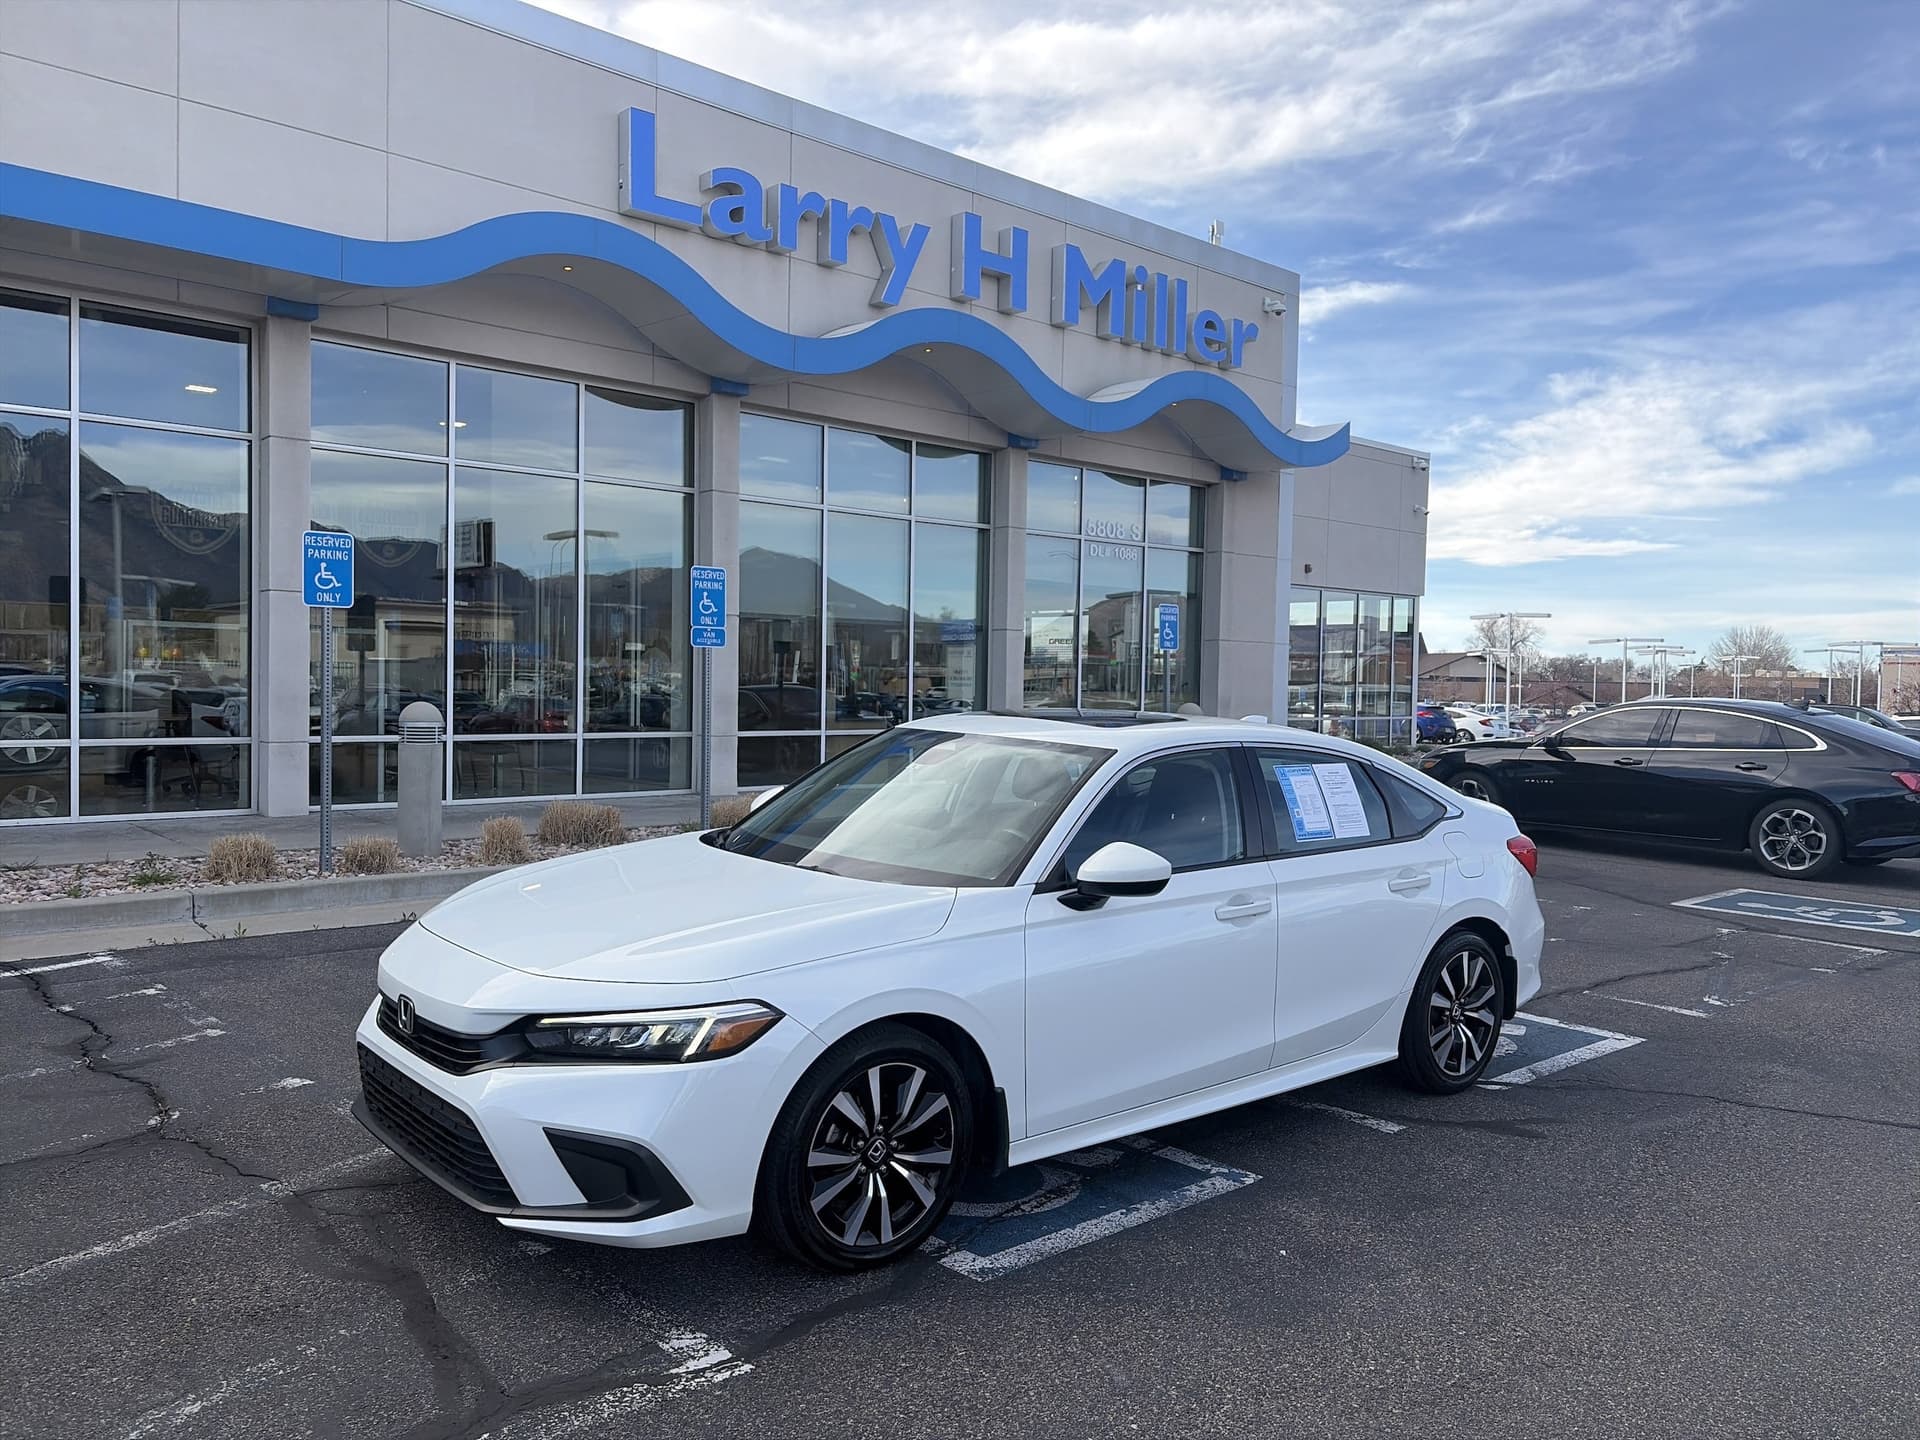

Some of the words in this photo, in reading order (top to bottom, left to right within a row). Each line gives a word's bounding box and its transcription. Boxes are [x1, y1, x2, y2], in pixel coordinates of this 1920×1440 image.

[618, 106, 931, 307] Larry
[951, 211, 1029, 315] H
[1052, 243, 1259, 371] Miller
[1087, 519, 1125, 539] 5808
[1130, 522, 1141, 541] S
[305, 535, 352, 549] RESERVED
[307, 548, 349, 561] PARKING
[692, 569, 725, 580] RESERVED
[694, 580, 723, 590] PARKING
[316, 591, 342, 603] ONLY
[700, 616, 718, 625] ONLY
[702, 631, 716, 639] VAN
